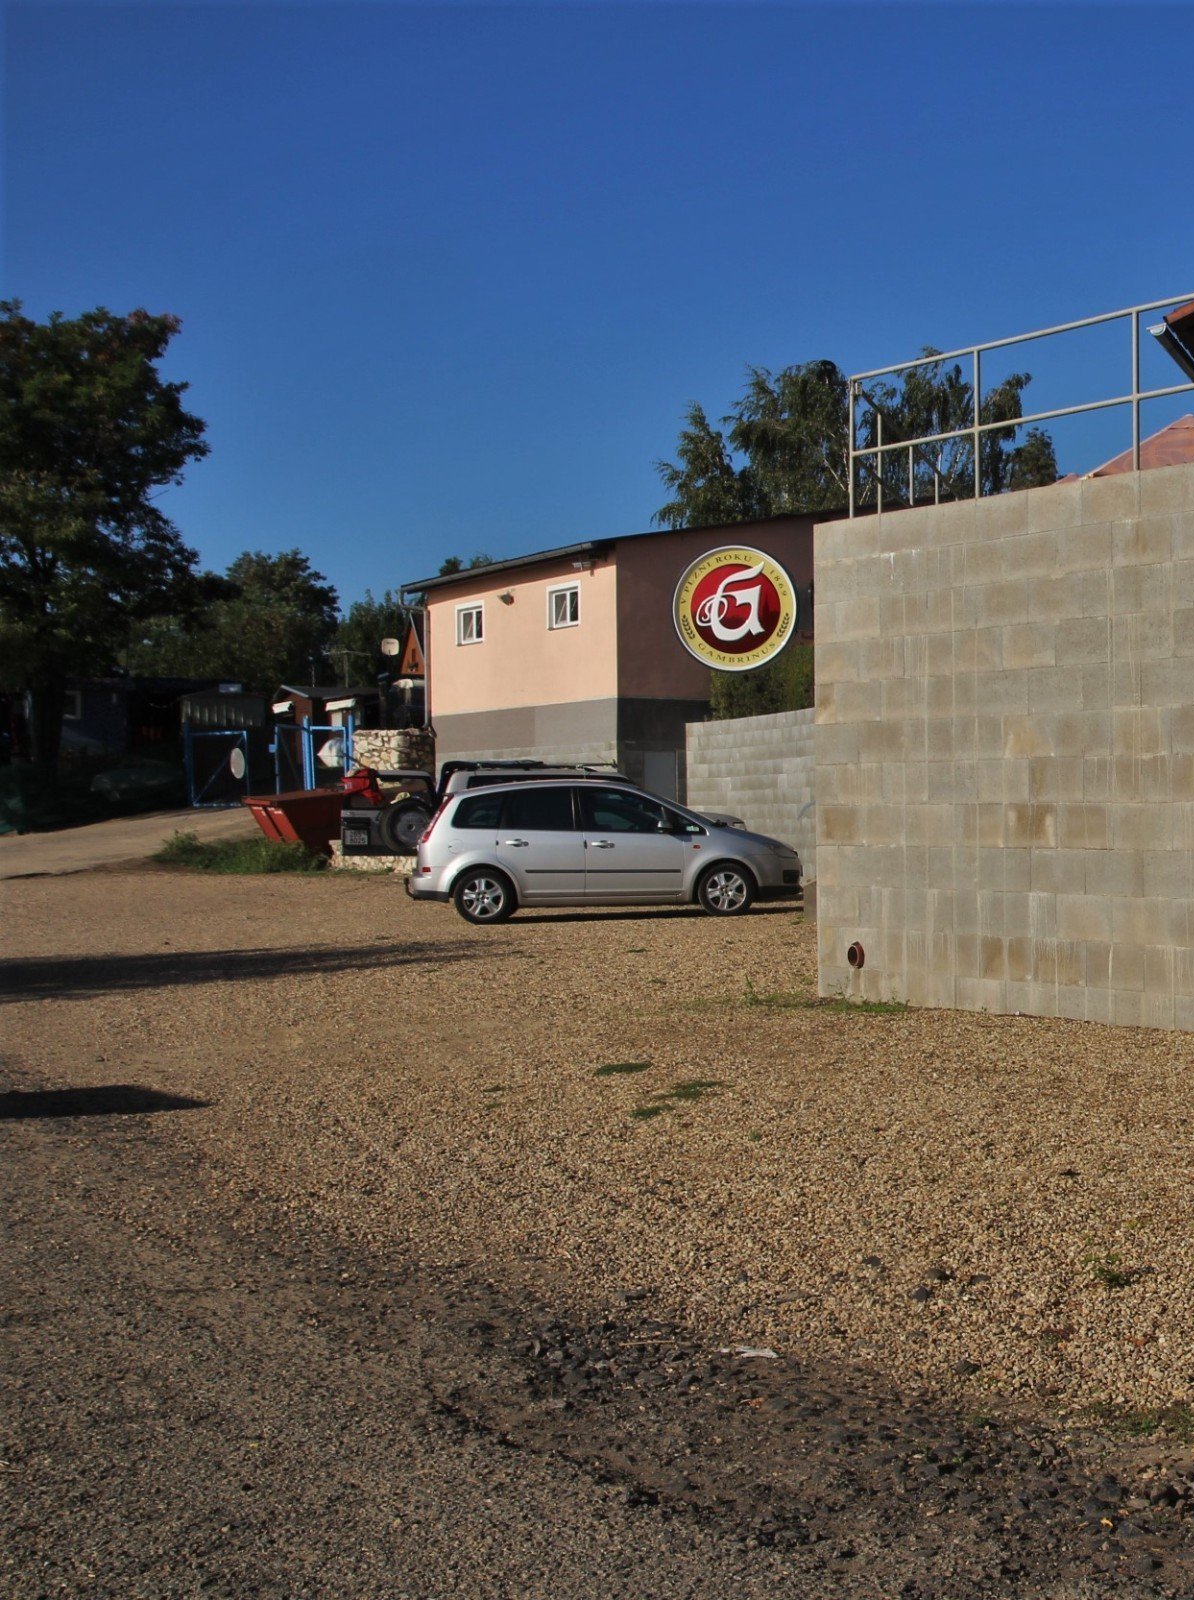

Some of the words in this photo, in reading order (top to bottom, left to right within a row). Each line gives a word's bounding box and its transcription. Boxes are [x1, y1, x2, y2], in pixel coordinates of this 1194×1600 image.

[715, 553, 753, 563] ROKU
[769, 569, 788, 596] 1869
[698, 642, 776, 663] GAMBRINUS
